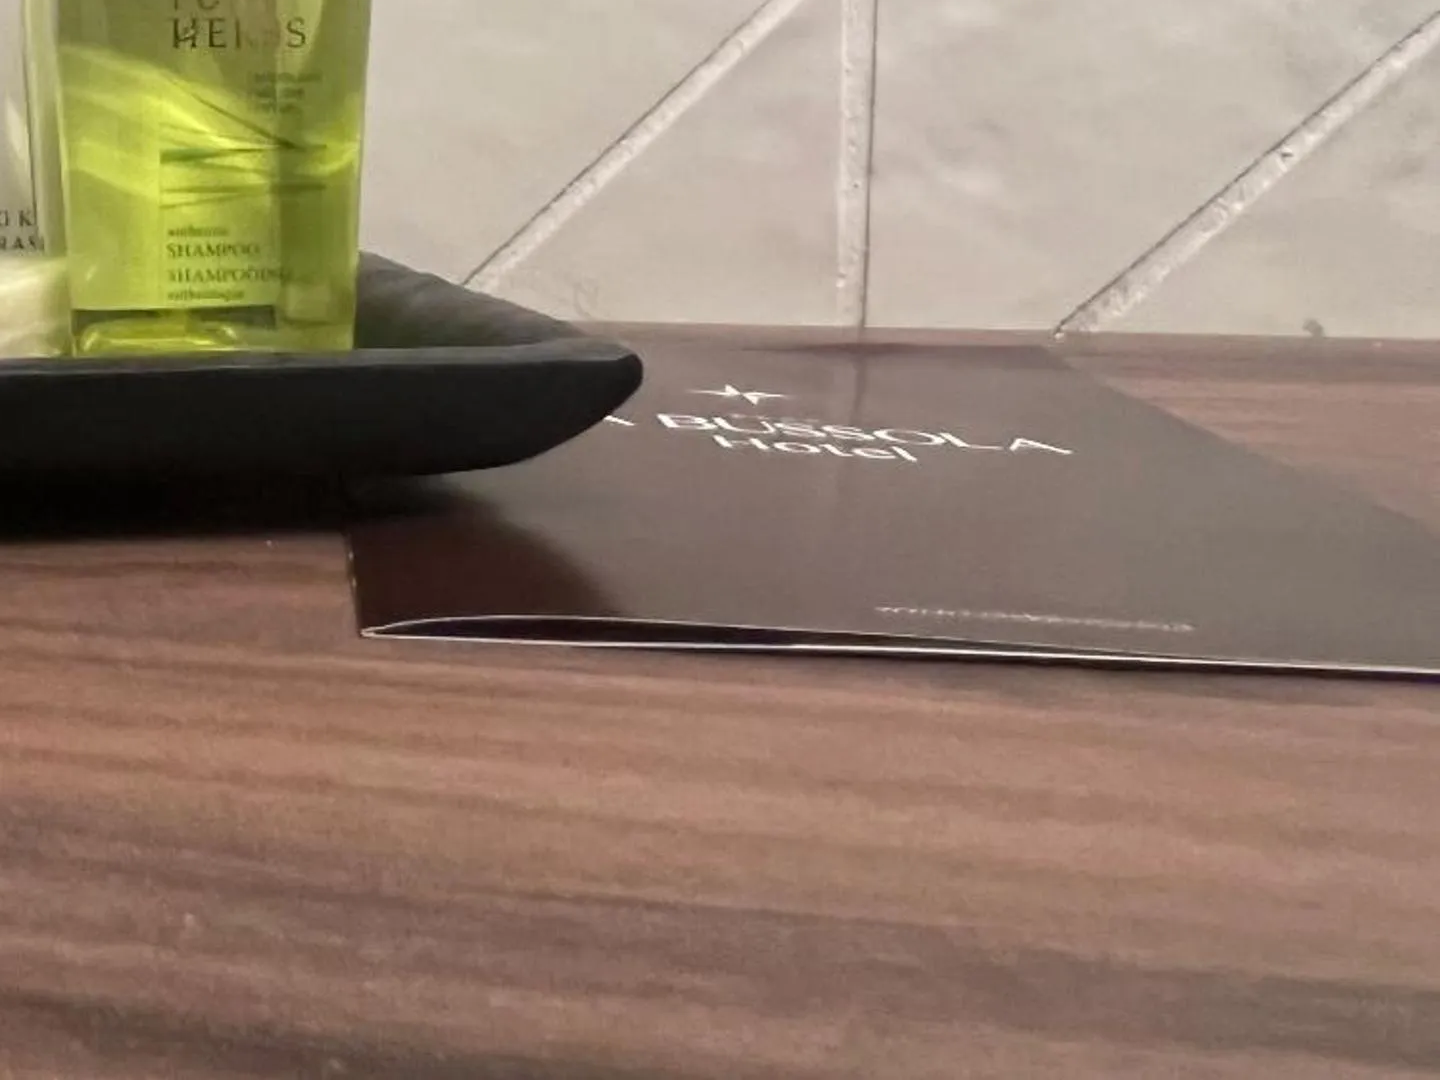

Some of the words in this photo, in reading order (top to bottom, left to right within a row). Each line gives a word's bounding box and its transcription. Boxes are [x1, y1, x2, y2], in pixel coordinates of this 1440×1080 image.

[166, 242, 261, 258] SHAMPOO
[657, 414, 1073, 455] BUSSOLA
[713, 435, 918, 463] Hotel
